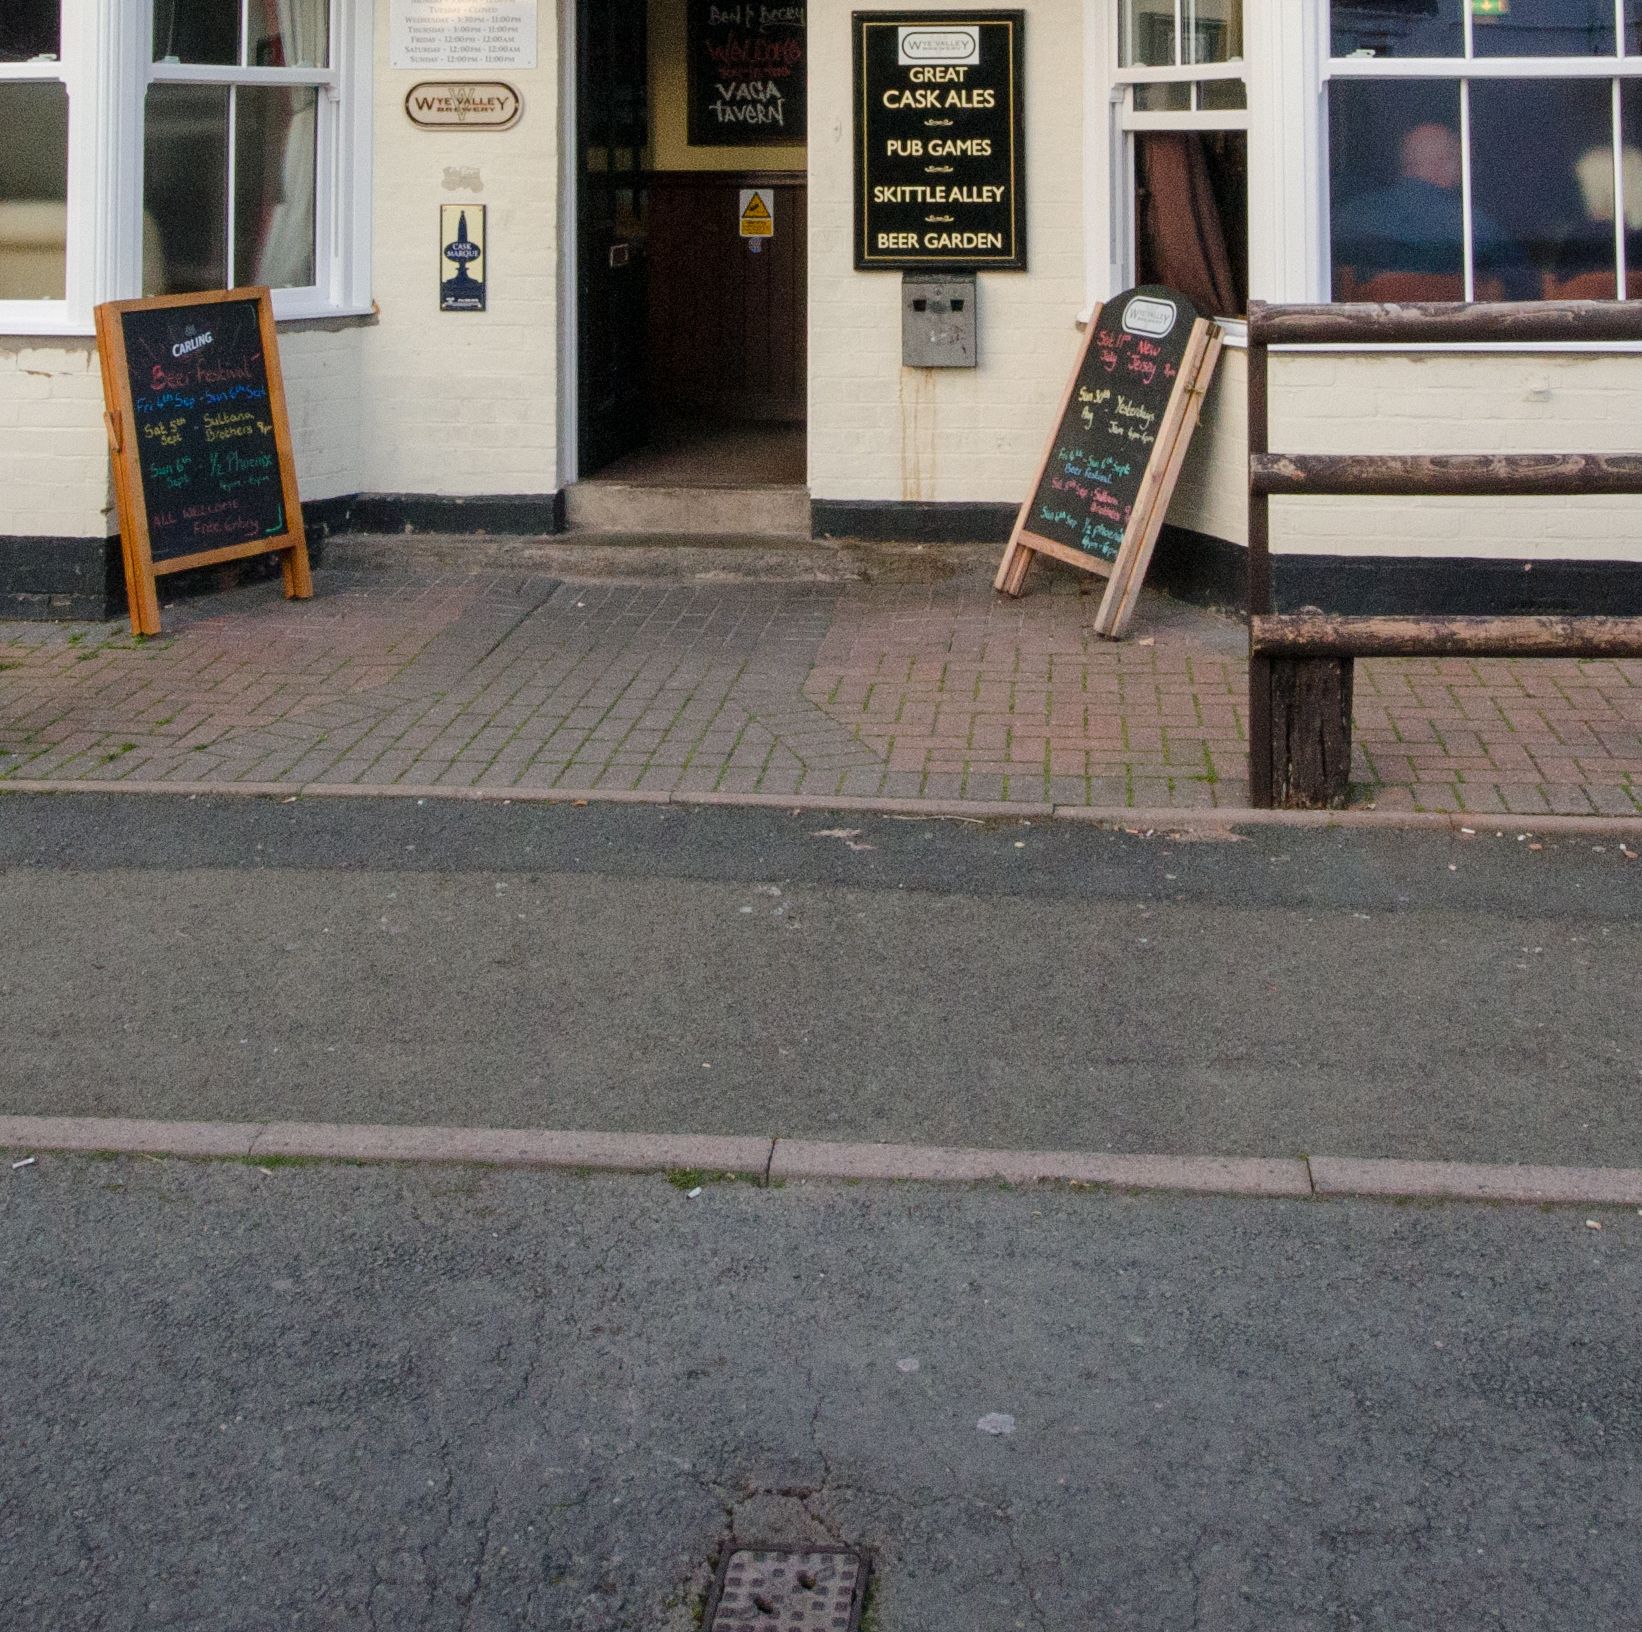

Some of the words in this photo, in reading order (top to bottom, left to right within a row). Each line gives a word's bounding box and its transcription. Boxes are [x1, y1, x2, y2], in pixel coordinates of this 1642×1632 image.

[908, 40, 933, 50] WYE
[936, 40, 969, 50] VALLEY
[909, 67, 968, 83] GREAT
[715, 80, 783, 103] VAGA
[883, 89, 941, 108] CASK
[945, 89, 995, 108] ALES
[415, 97, 452, 110] WYE
[457, 97, 509, 110] VALLEY
[886, 140, 923, 156] PUB
[928, 140, 992, 156] GAMES
[873, 186, 946, 202] SKITTLE
[949, 186, 1004, 202] ALLEY
[877, 233, 919, 248] BEER
[924, 233, 1002, 248] GARDEN
[447, 250, 479, 259] MARQUE
[172, 331, 214, 357] CARLING
[150, 365, 190, 390] Beer
[203, 412, 255, 428] Sultana
[144, 421, 168, 438] Sat
[205, 425, 253, 442] Brothers
[150, 462, 173, 478] Sun
